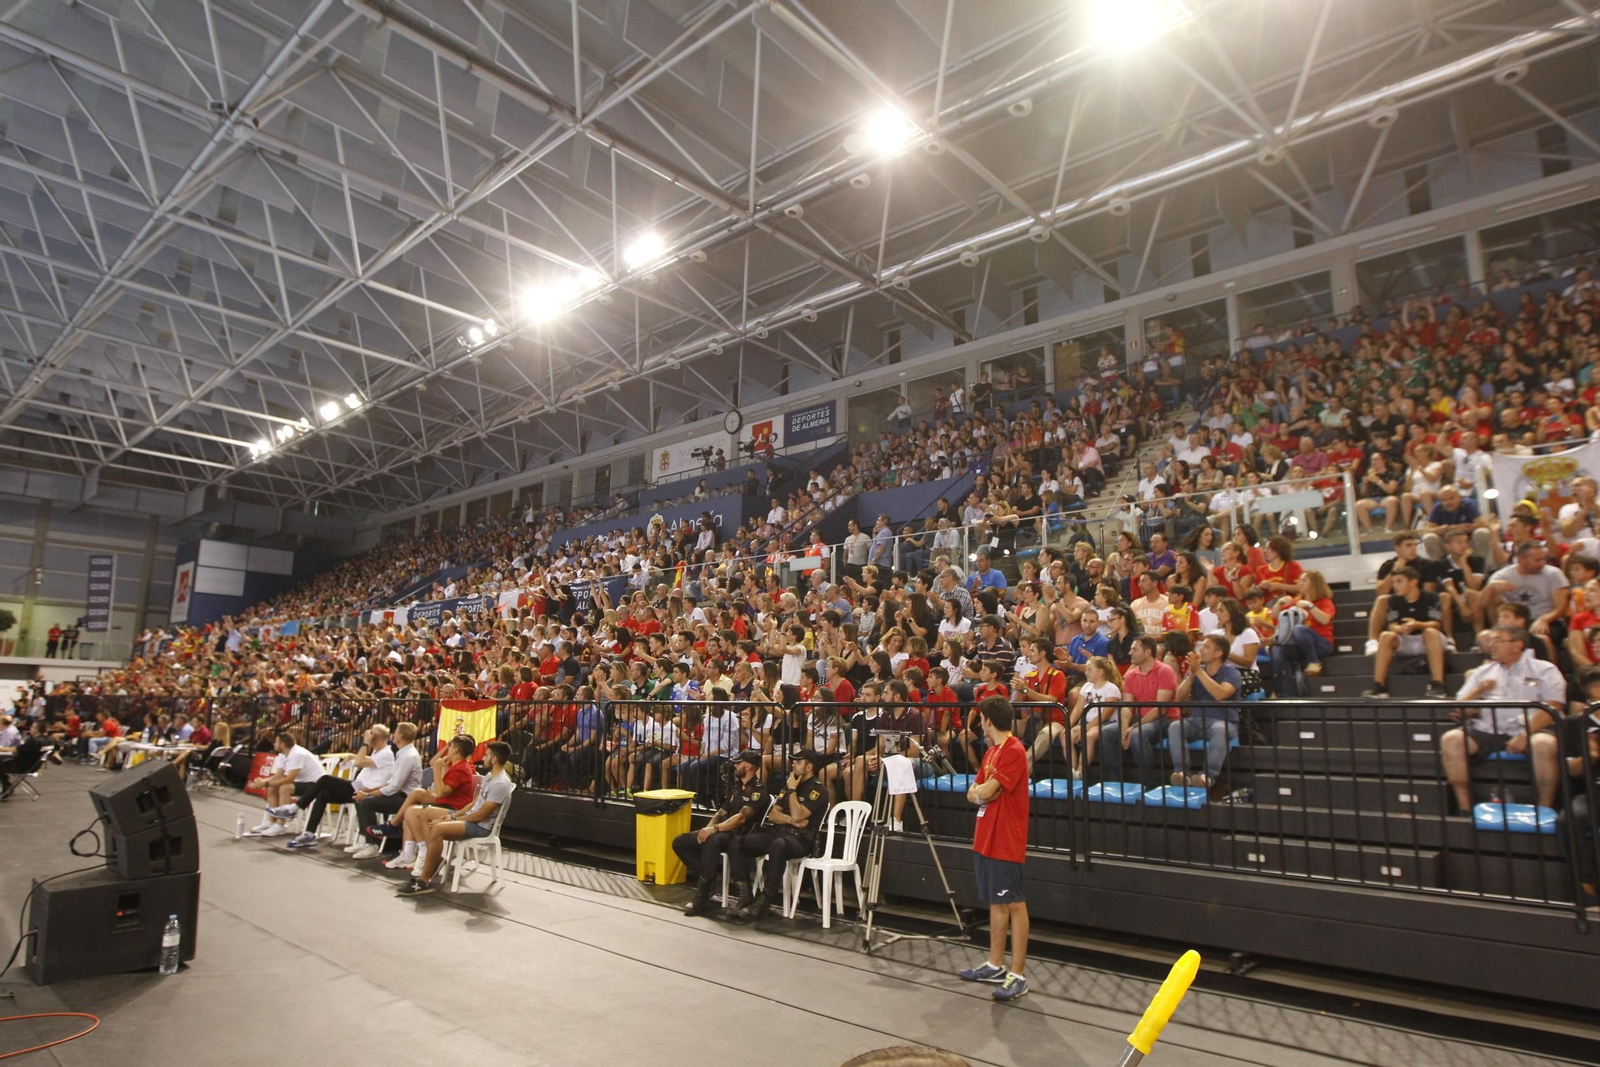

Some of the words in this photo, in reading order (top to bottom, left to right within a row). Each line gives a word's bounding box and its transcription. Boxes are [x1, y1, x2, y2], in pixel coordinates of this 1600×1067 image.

[791, 409, 830, 425] DEPORTES
[791, 424, 801, 433] DE
[671, 510, 723, 531] Almea
[413, 608, 440, 619] DEPORTES
